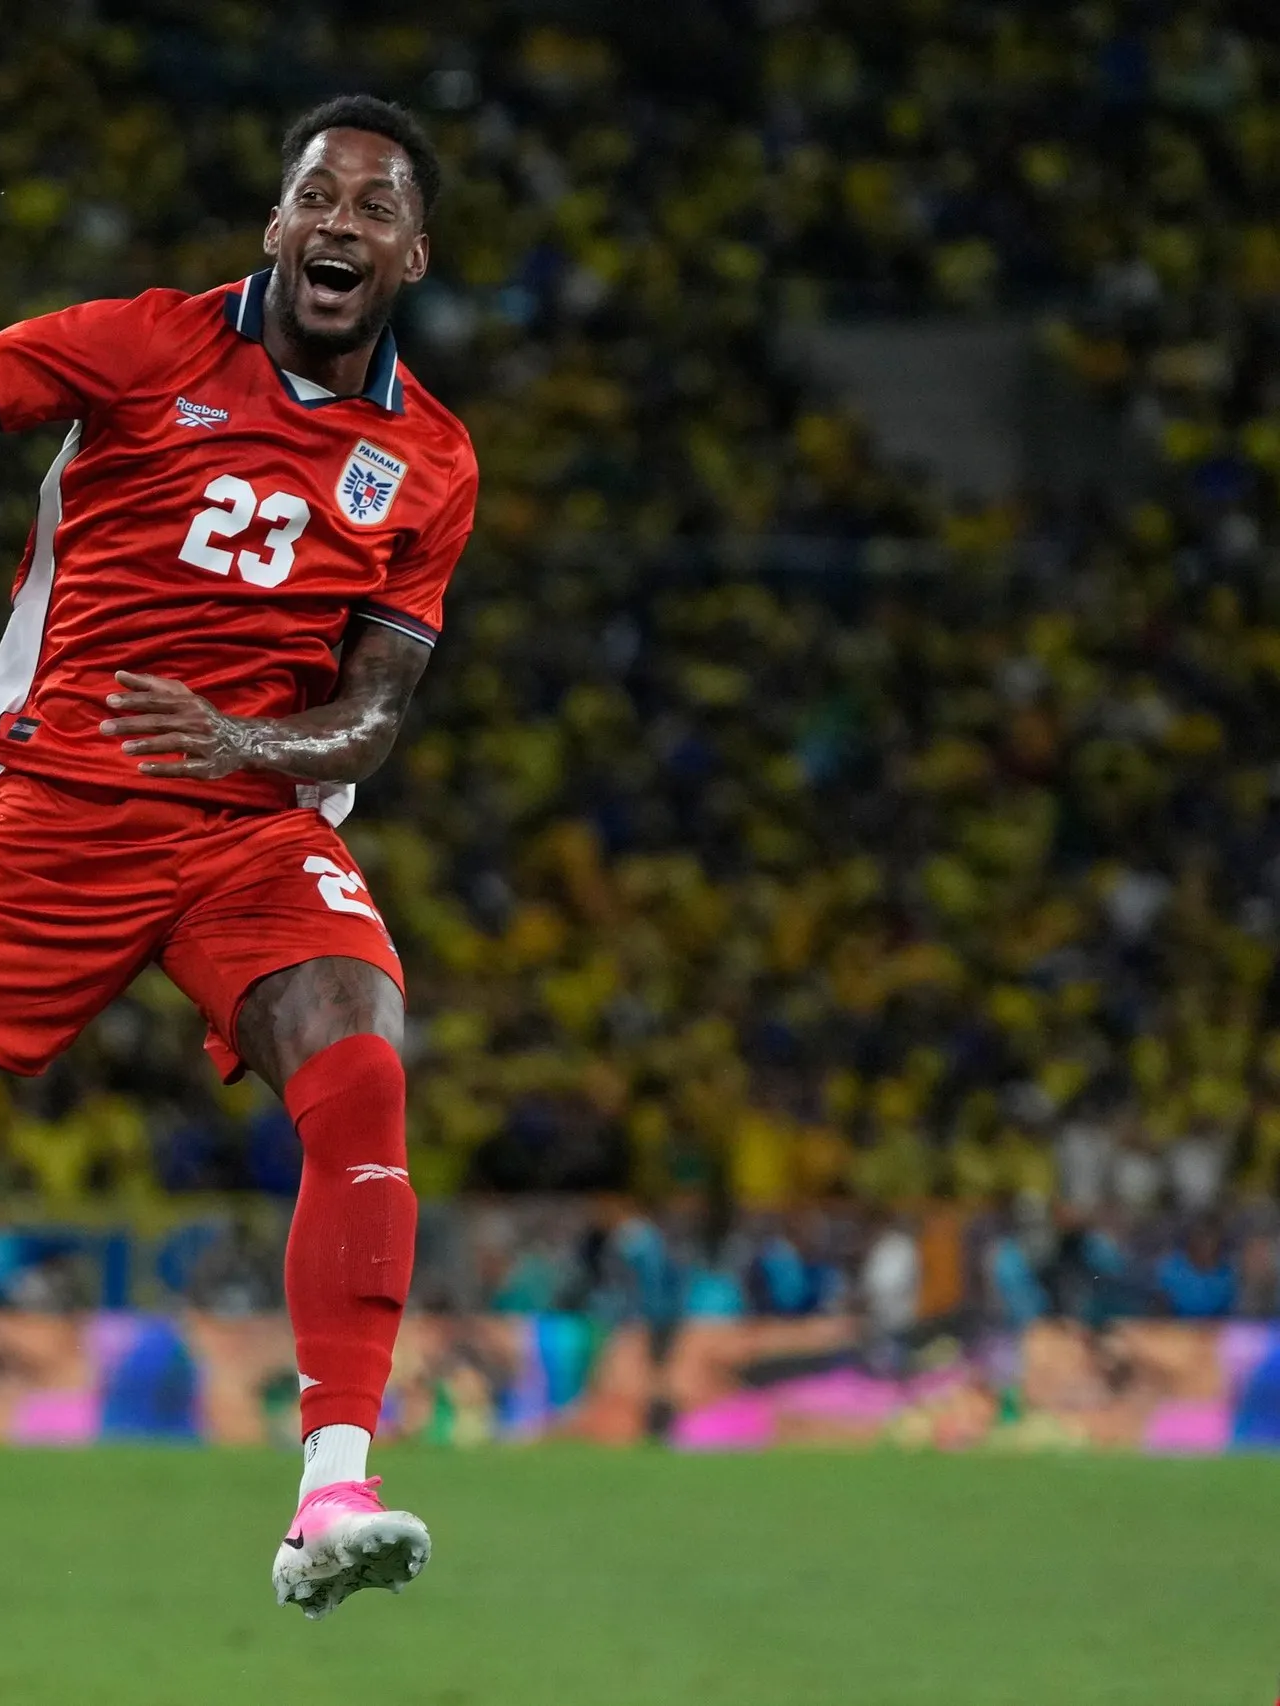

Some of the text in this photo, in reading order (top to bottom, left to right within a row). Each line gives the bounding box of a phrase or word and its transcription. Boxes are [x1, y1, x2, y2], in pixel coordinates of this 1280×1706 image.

[176, 396, 229, 419] Reebok
[178, 474, 311, 588] 23
[303, 856, 385, 931] 2
